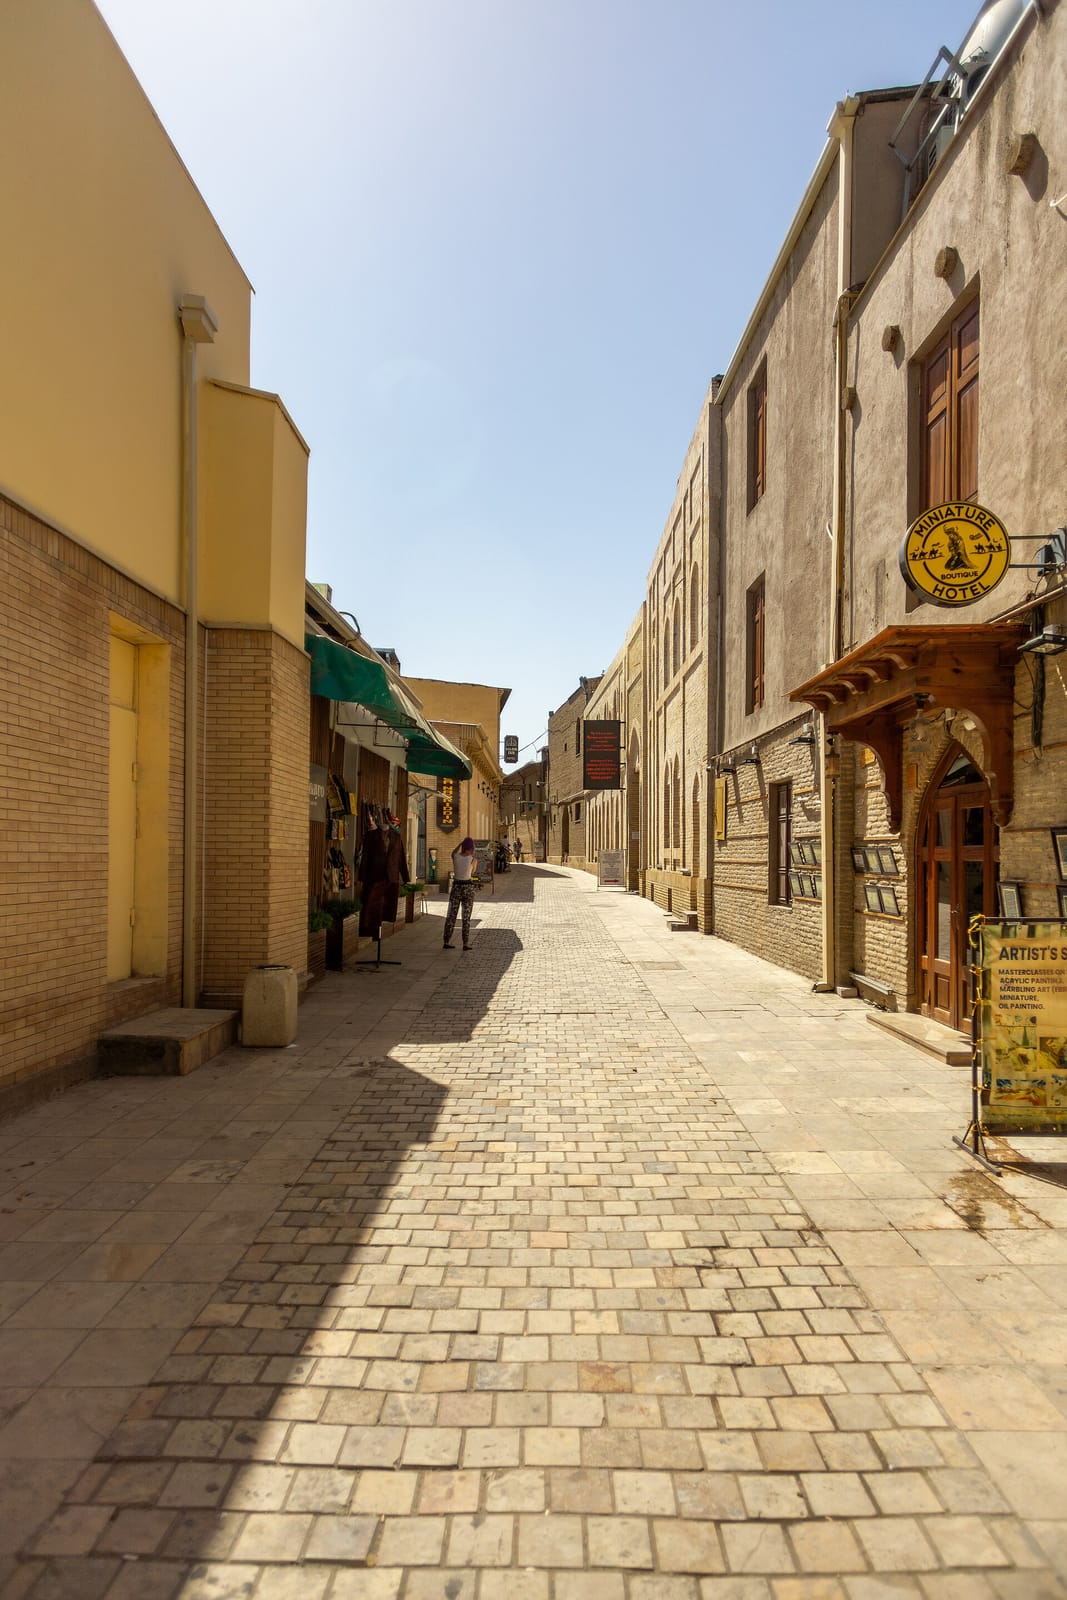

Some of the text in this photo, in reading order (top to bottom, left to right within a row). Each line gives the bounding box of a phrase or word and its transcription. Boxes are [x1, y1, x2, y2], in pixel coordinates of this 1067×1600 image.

[914, 505, 996, 538] MINIATURE
[940, 570, 979, 580] BOUTIQUE
[932, 581, 991, 600] HOTEL
[999, 945, 1058, 961] ARTIST'S
